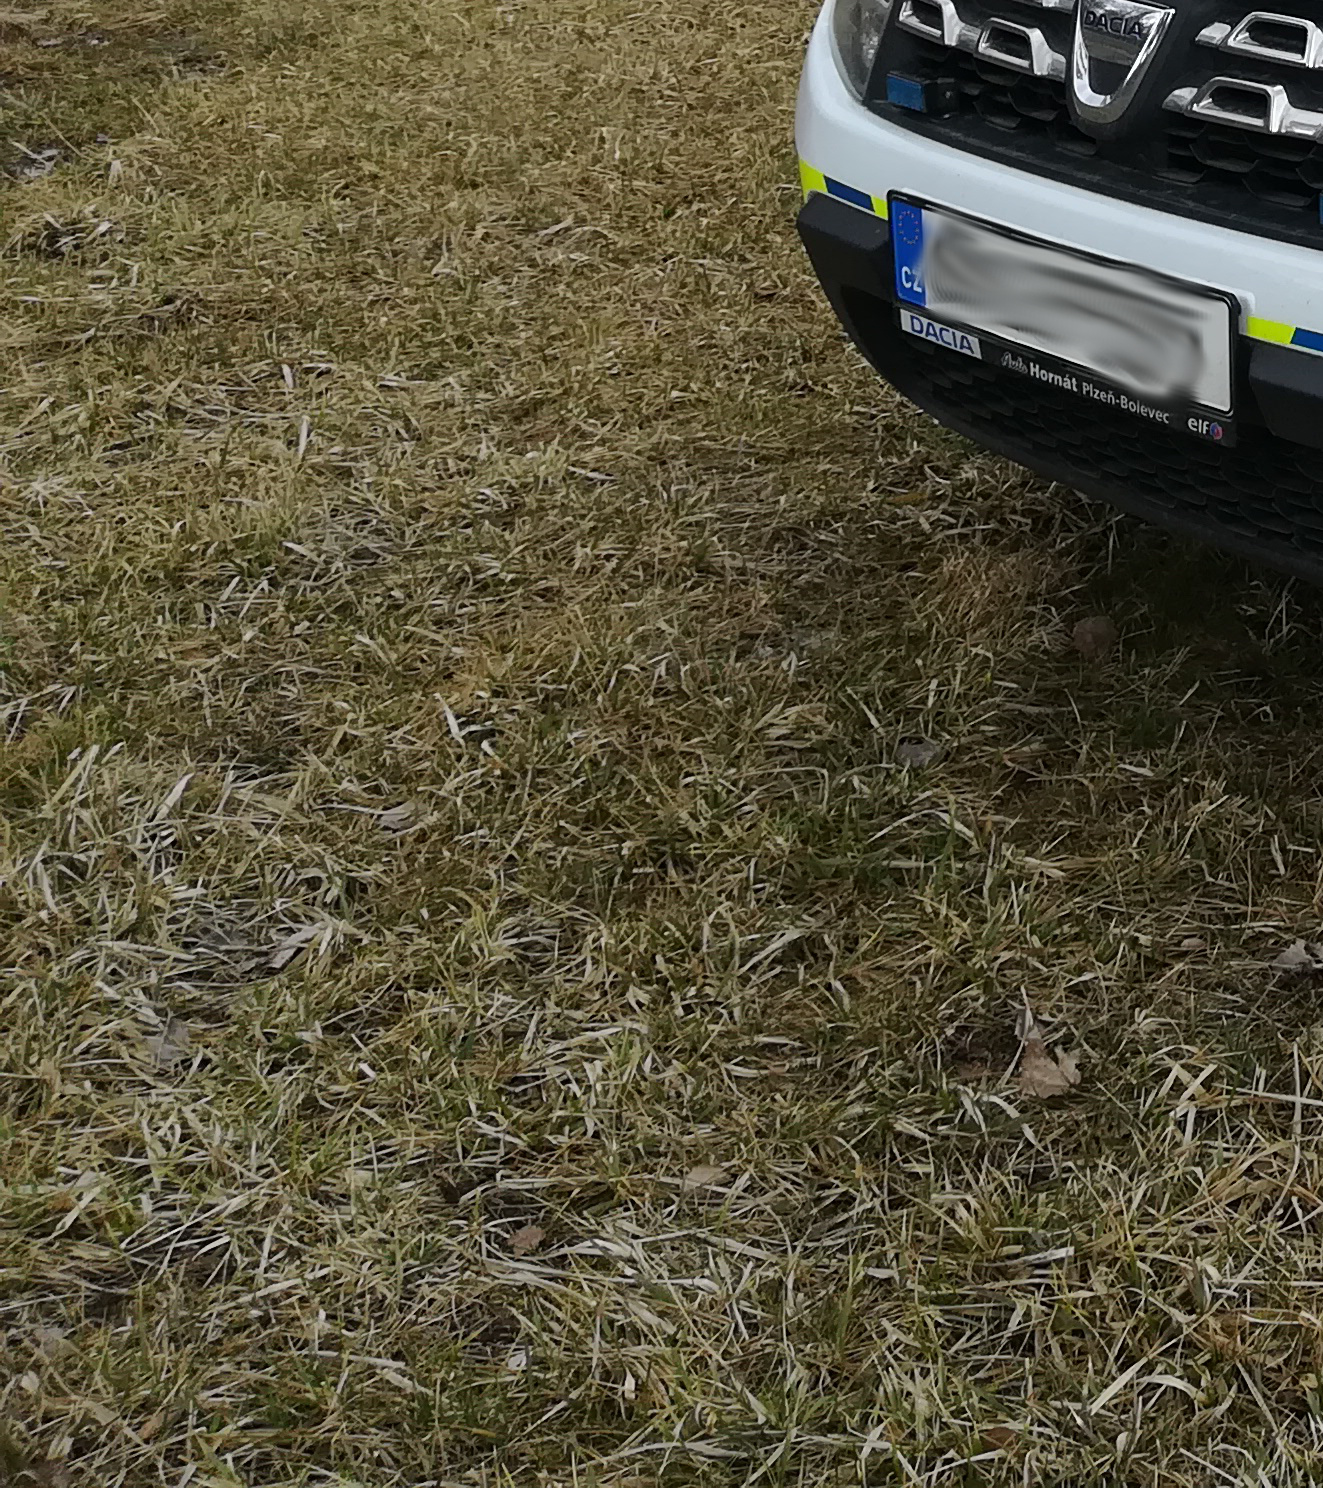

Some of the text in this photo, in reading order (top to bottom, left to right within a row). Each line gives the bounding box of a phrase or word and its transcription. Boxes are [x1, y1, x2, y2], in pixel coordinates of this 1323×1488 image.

[1084, 10, 1142, 39] DACIA
[901, 266, 923, 293] CZ
[909, 314, 975, 355] DACIA
[1029, 361, 1078, 392] Hornát
[1082, 381, 1170, 424] Plzeň-Bolevec
